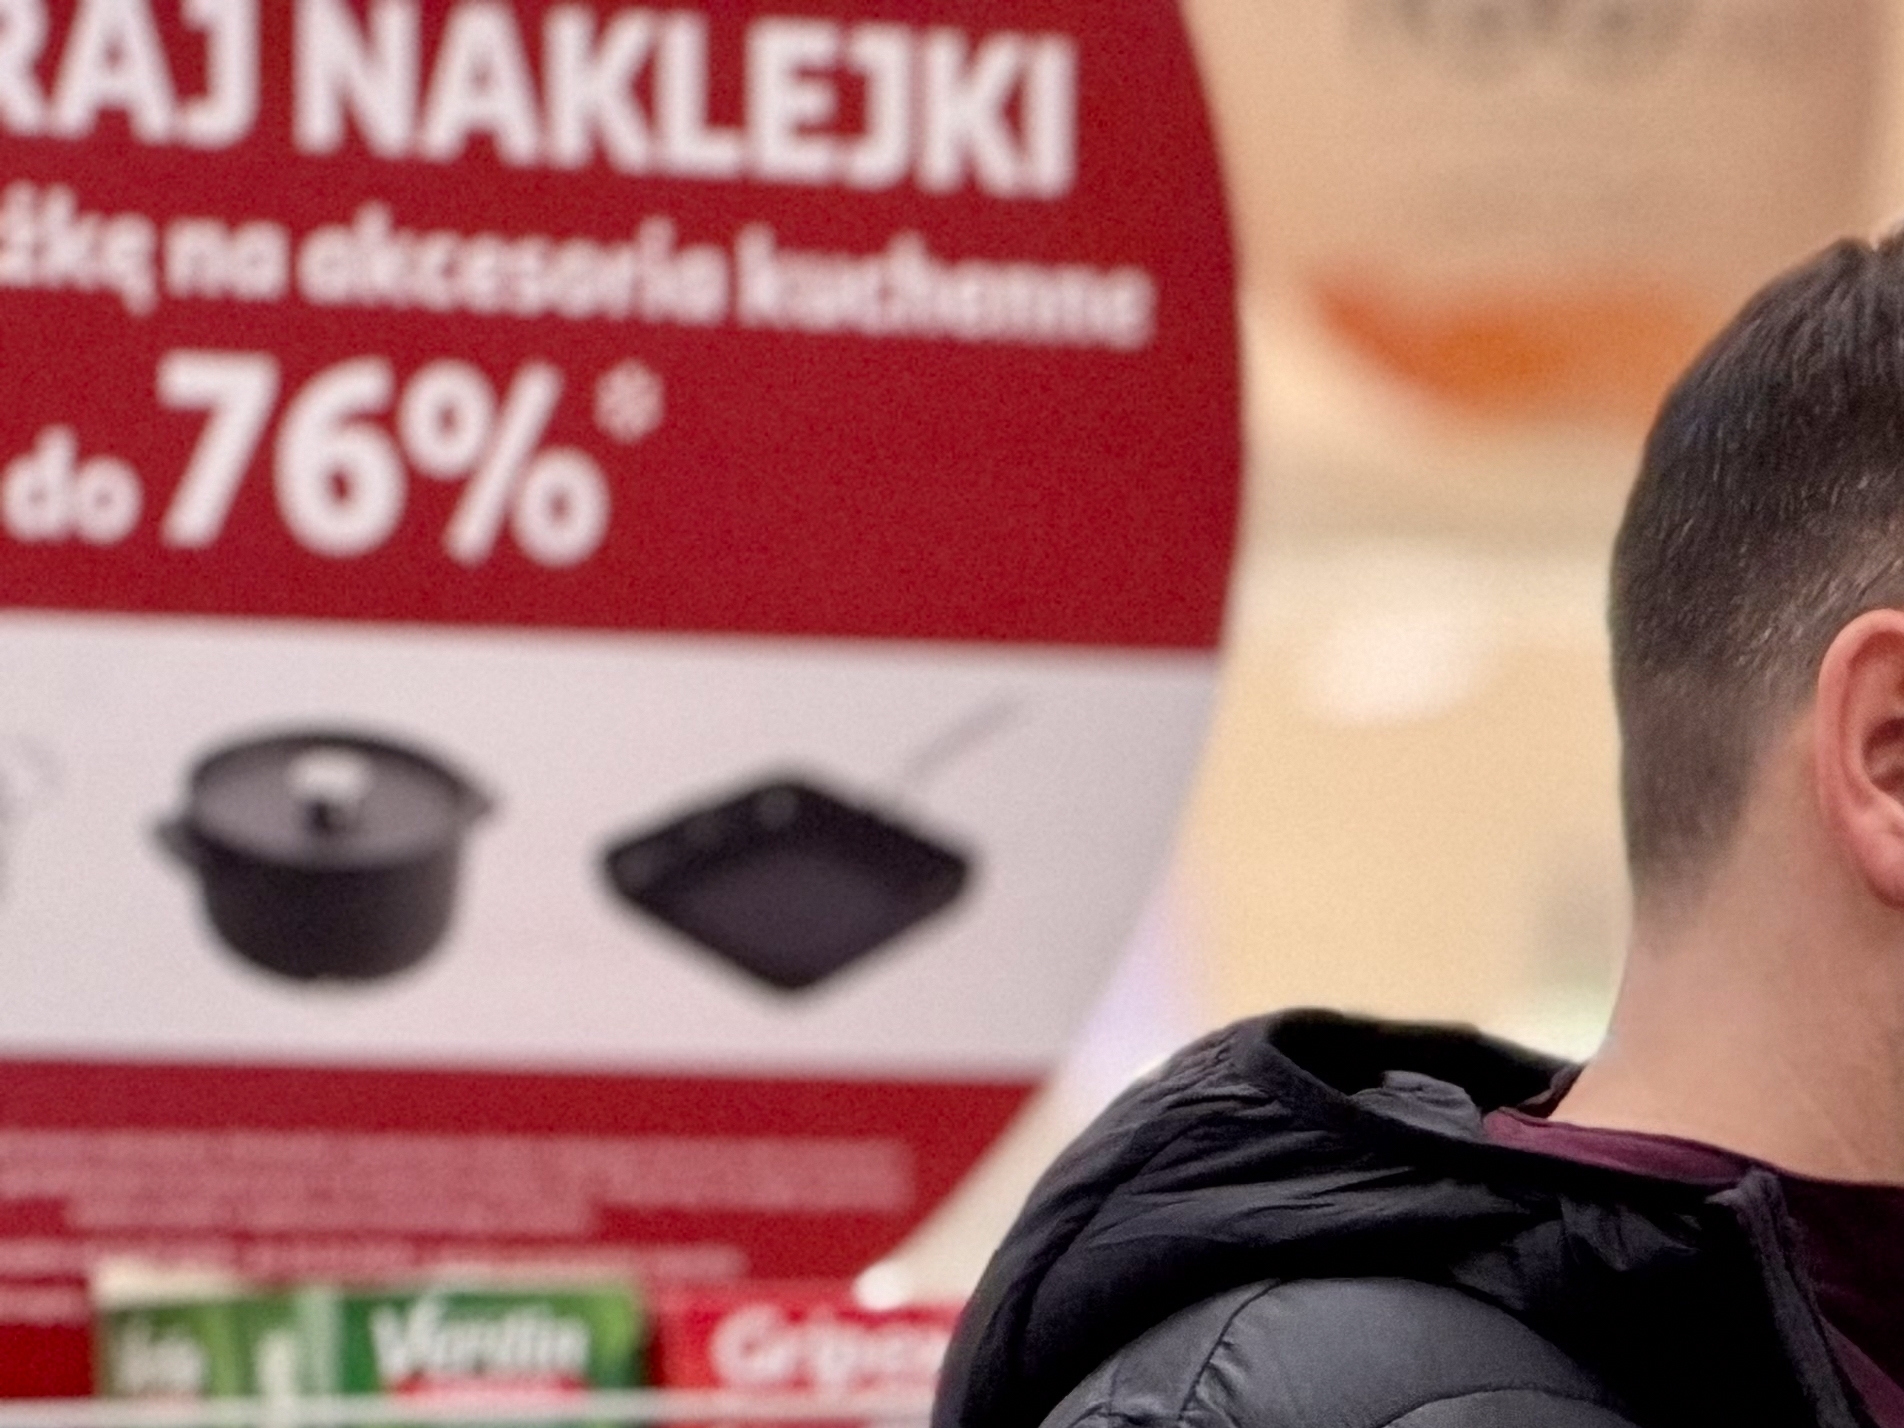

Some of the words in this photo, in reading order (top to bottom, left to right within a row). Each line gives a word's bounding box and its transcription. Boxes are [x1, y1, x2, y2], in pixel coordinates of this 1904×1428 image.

[290, 0, 1080, 197] NAKLEJKI
[163, 213, 290, 302] na
[296, 200, 731, 328] akcesoria
[735, 221, 1158, 352] kuchenne
[2, 425, 143, 547] do
